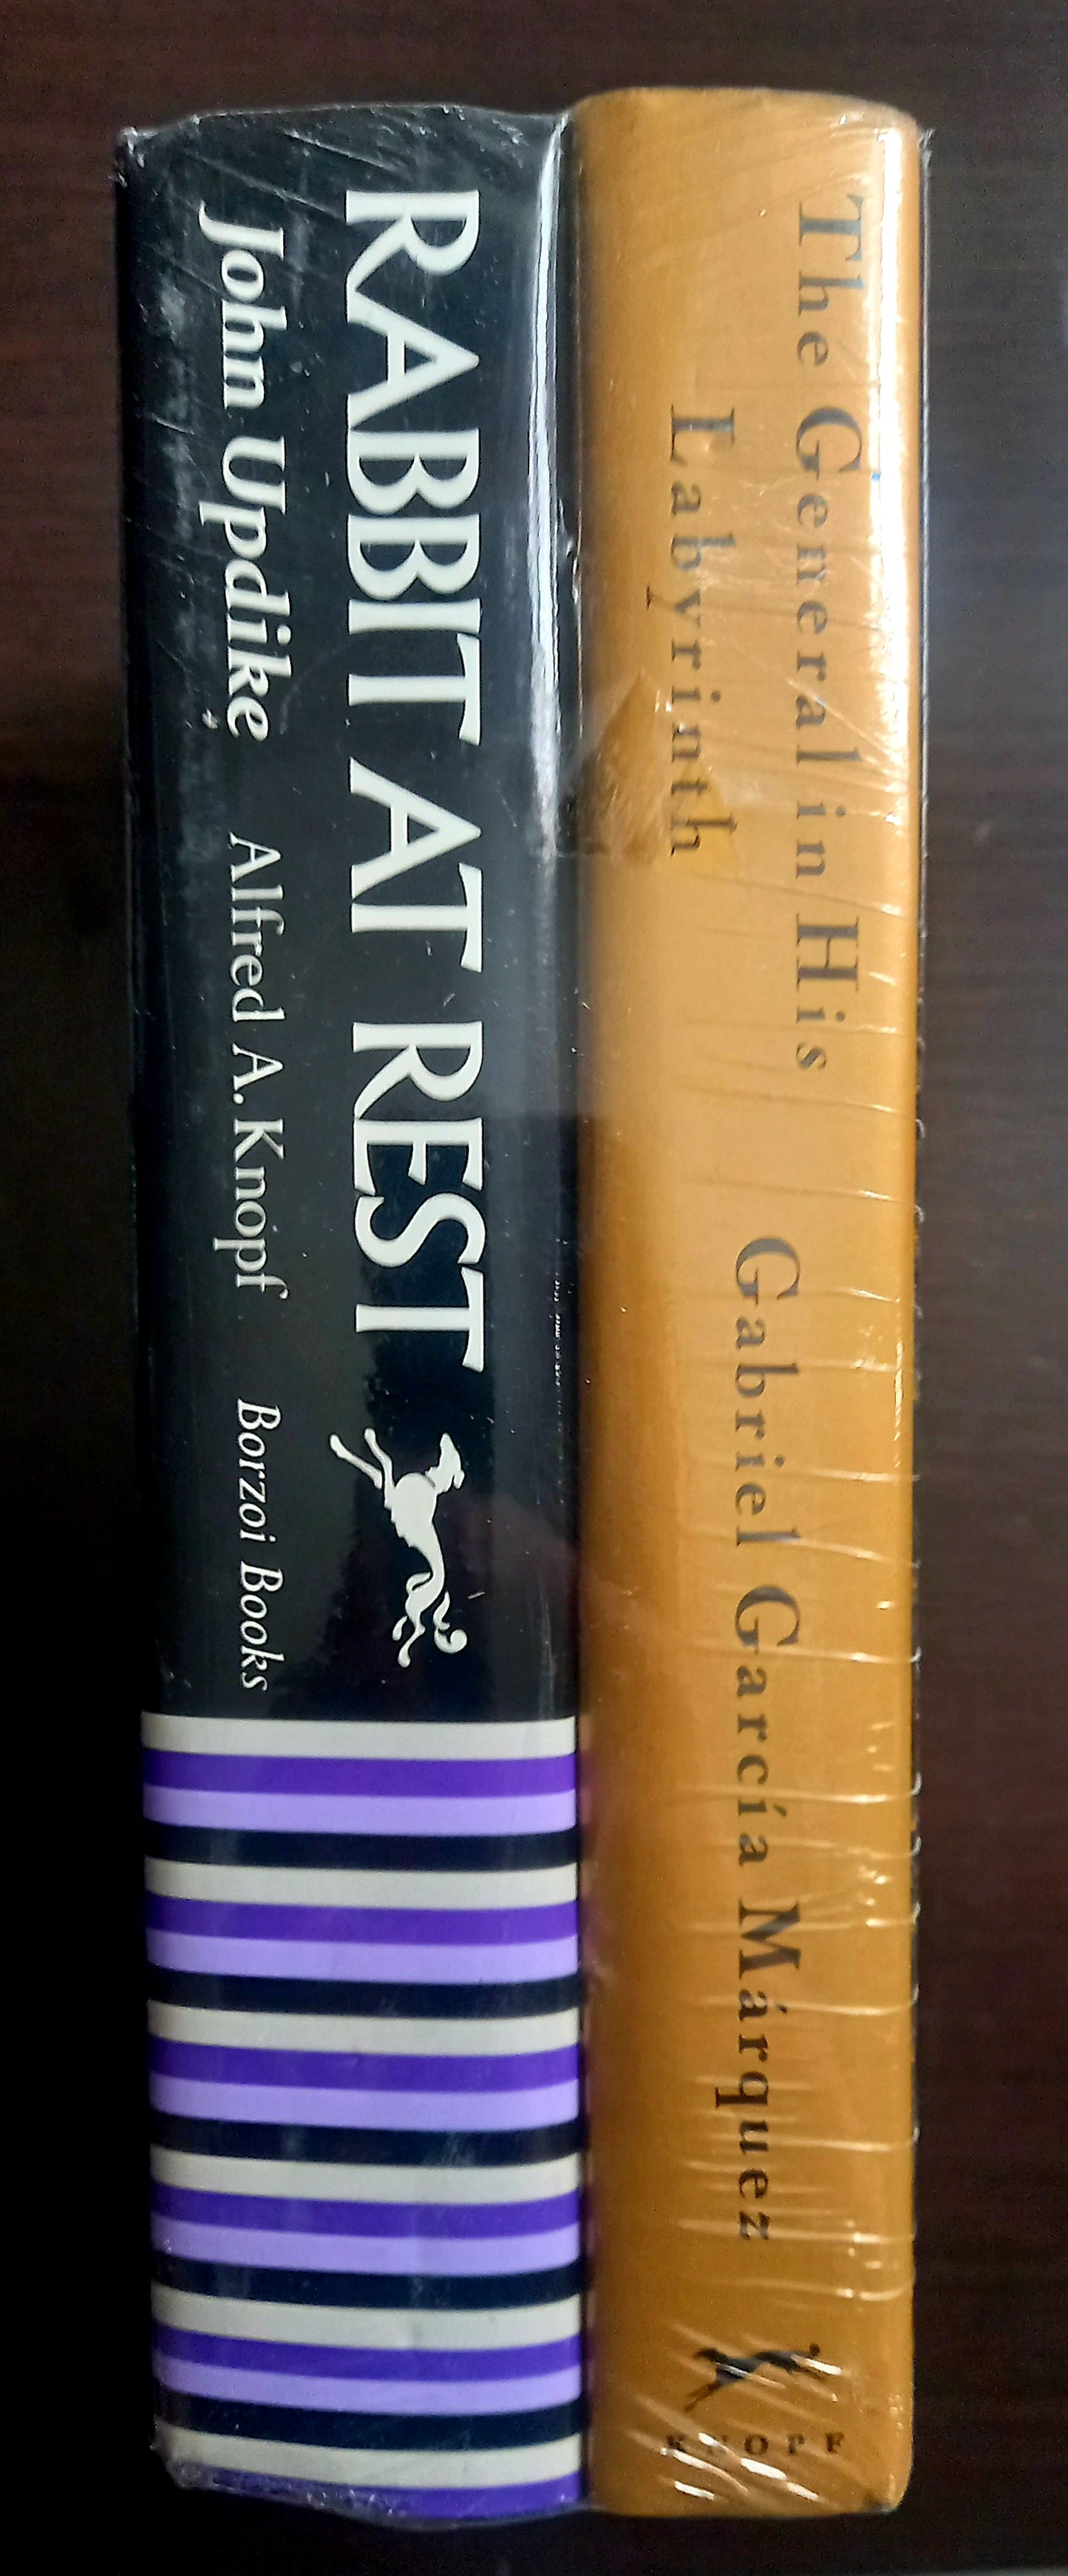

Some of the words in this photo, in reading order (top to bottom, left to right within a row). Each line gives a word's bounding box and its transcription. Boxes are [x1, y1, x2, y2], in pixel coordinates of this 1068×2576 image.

[198, 200, 288, 409] John
[797, 192, 865, 367] The
[346, 189, 480, 746] RABBIT
[199, 435, 293, 743] Updike
[645, 403, 738, 857] Labyrinth
[795, 405, 863, 763] General
[229, 831, 285, 1024] Alfred
[348, 757, 482, 973] AT
[795, 800, 846, 879] in
[231, 1043, 284, 1105] A.
[795, 913, 860, 1071] His
[213, 1117, 289, 1300] Knopf
[352, 1021, 486, 1373] REST
[236, 1397, 282, 1544] Borzoi
[734, 1235, 801, 1547] Gabriel
[238, 1563, 286, 1693] Books
[734, 1584, 801, 1867] García
[714, 1898, 801, 2241] Márquez
